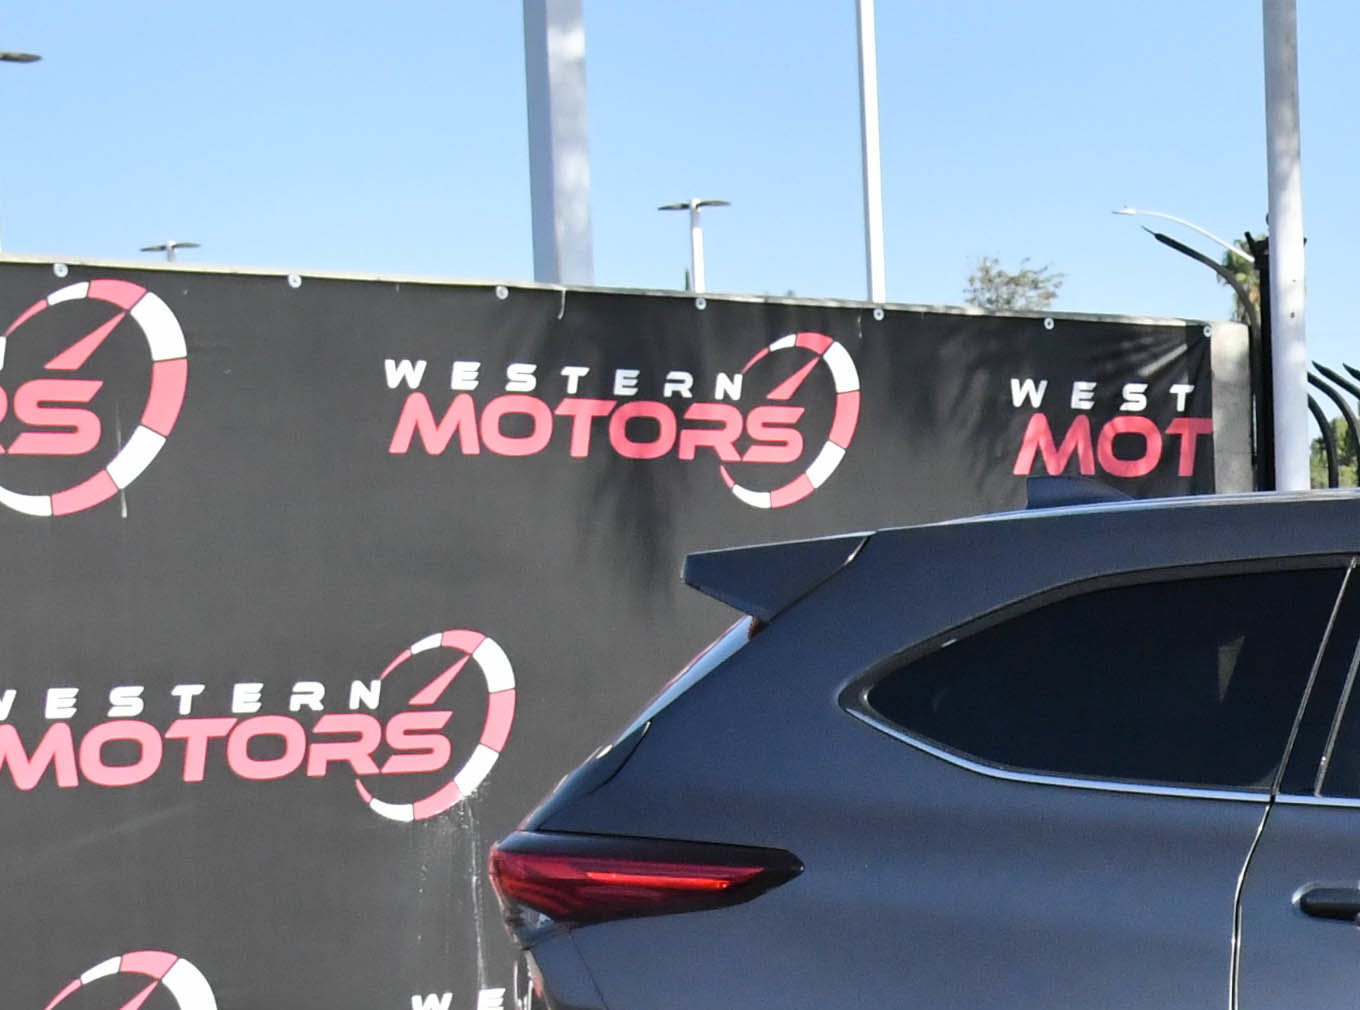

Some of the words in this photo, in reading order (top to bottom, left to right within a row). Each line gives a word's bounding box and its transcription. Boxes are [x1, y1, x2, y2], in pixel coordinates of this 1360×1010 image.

[384, 358, 744, 401] WESTERN
[1010, 378, 1195, 412] WEST
[0, 378, 104, 455] S
[388, 391, 805, 464] MOTORS
[1013, 412, 1214, 478] MOT
[0, 710, 454, 791] MOTORS
